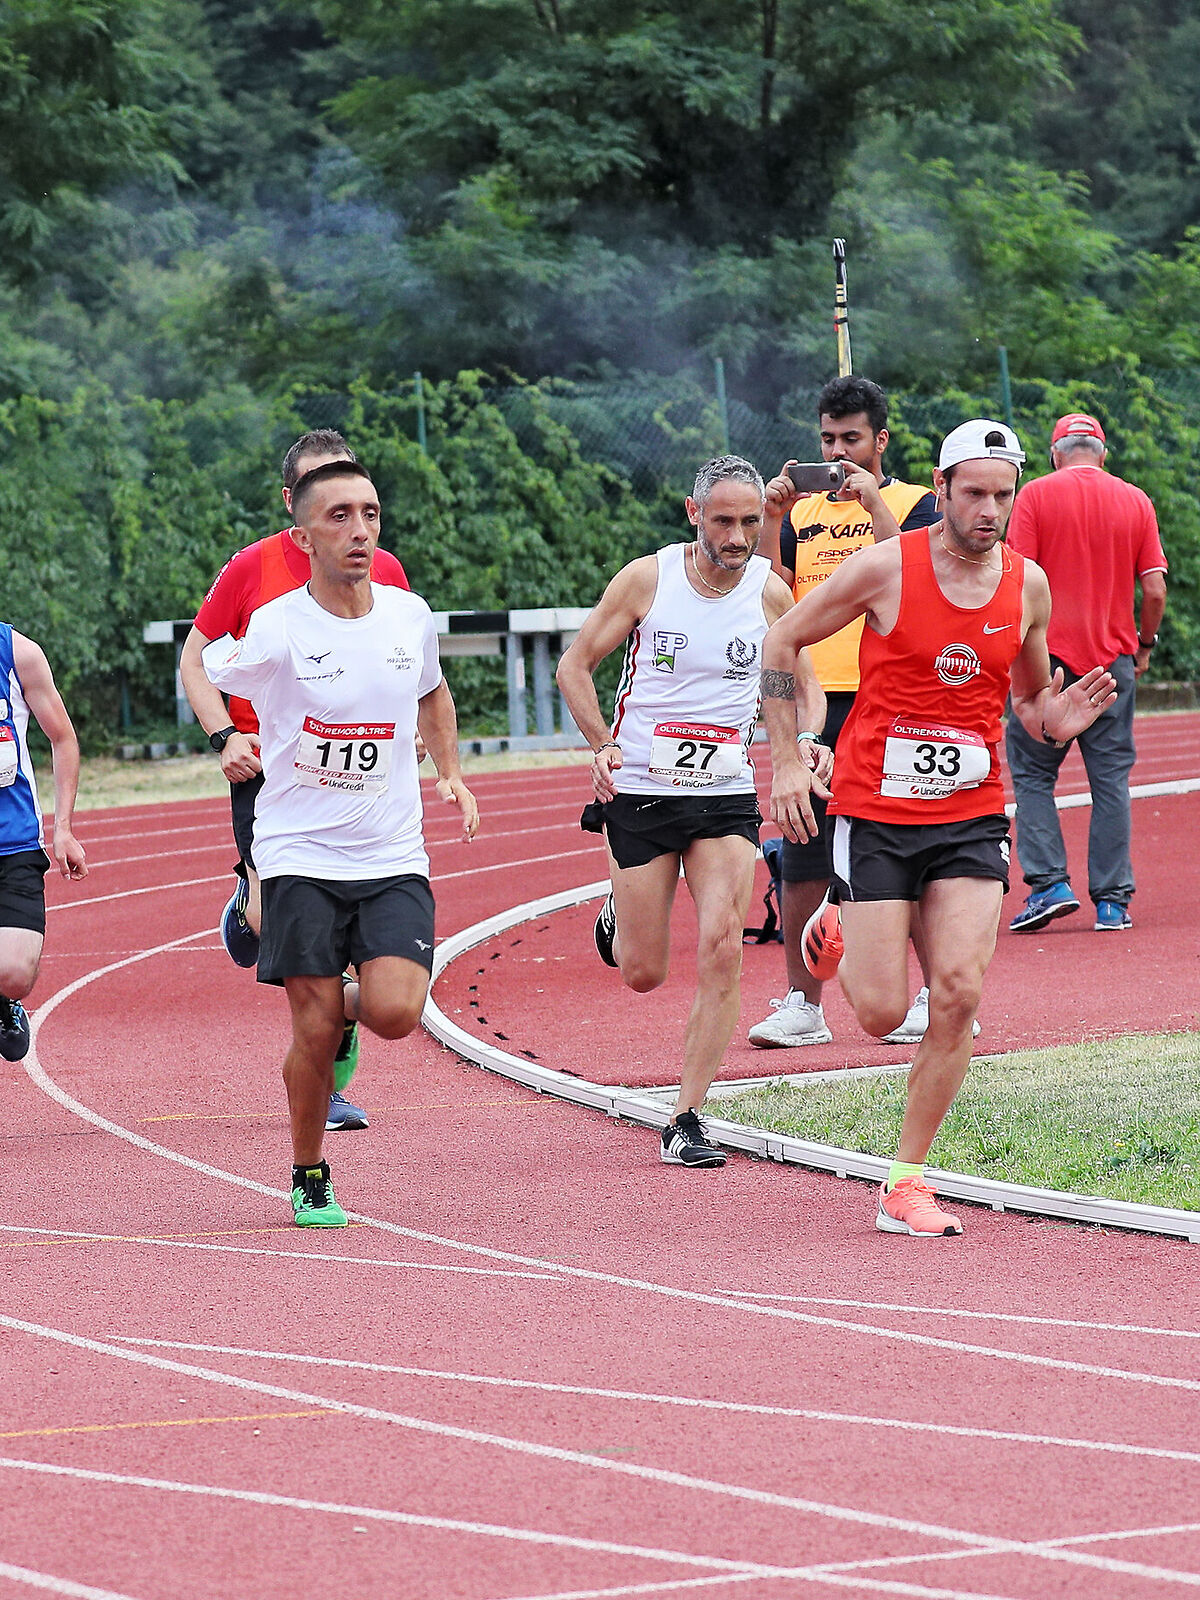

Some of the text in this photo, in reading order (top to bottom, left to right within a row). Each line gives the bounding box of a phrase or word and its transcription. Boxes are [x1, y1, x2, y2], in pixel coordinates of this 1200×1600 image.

[829, 522, 874, 539] KARH
[316, 741, 378, 772] 119
[675, 741, 718, 770] 27
[913, 744, 960, 777] 33
[328, 779, 364, 791] UniCredit
